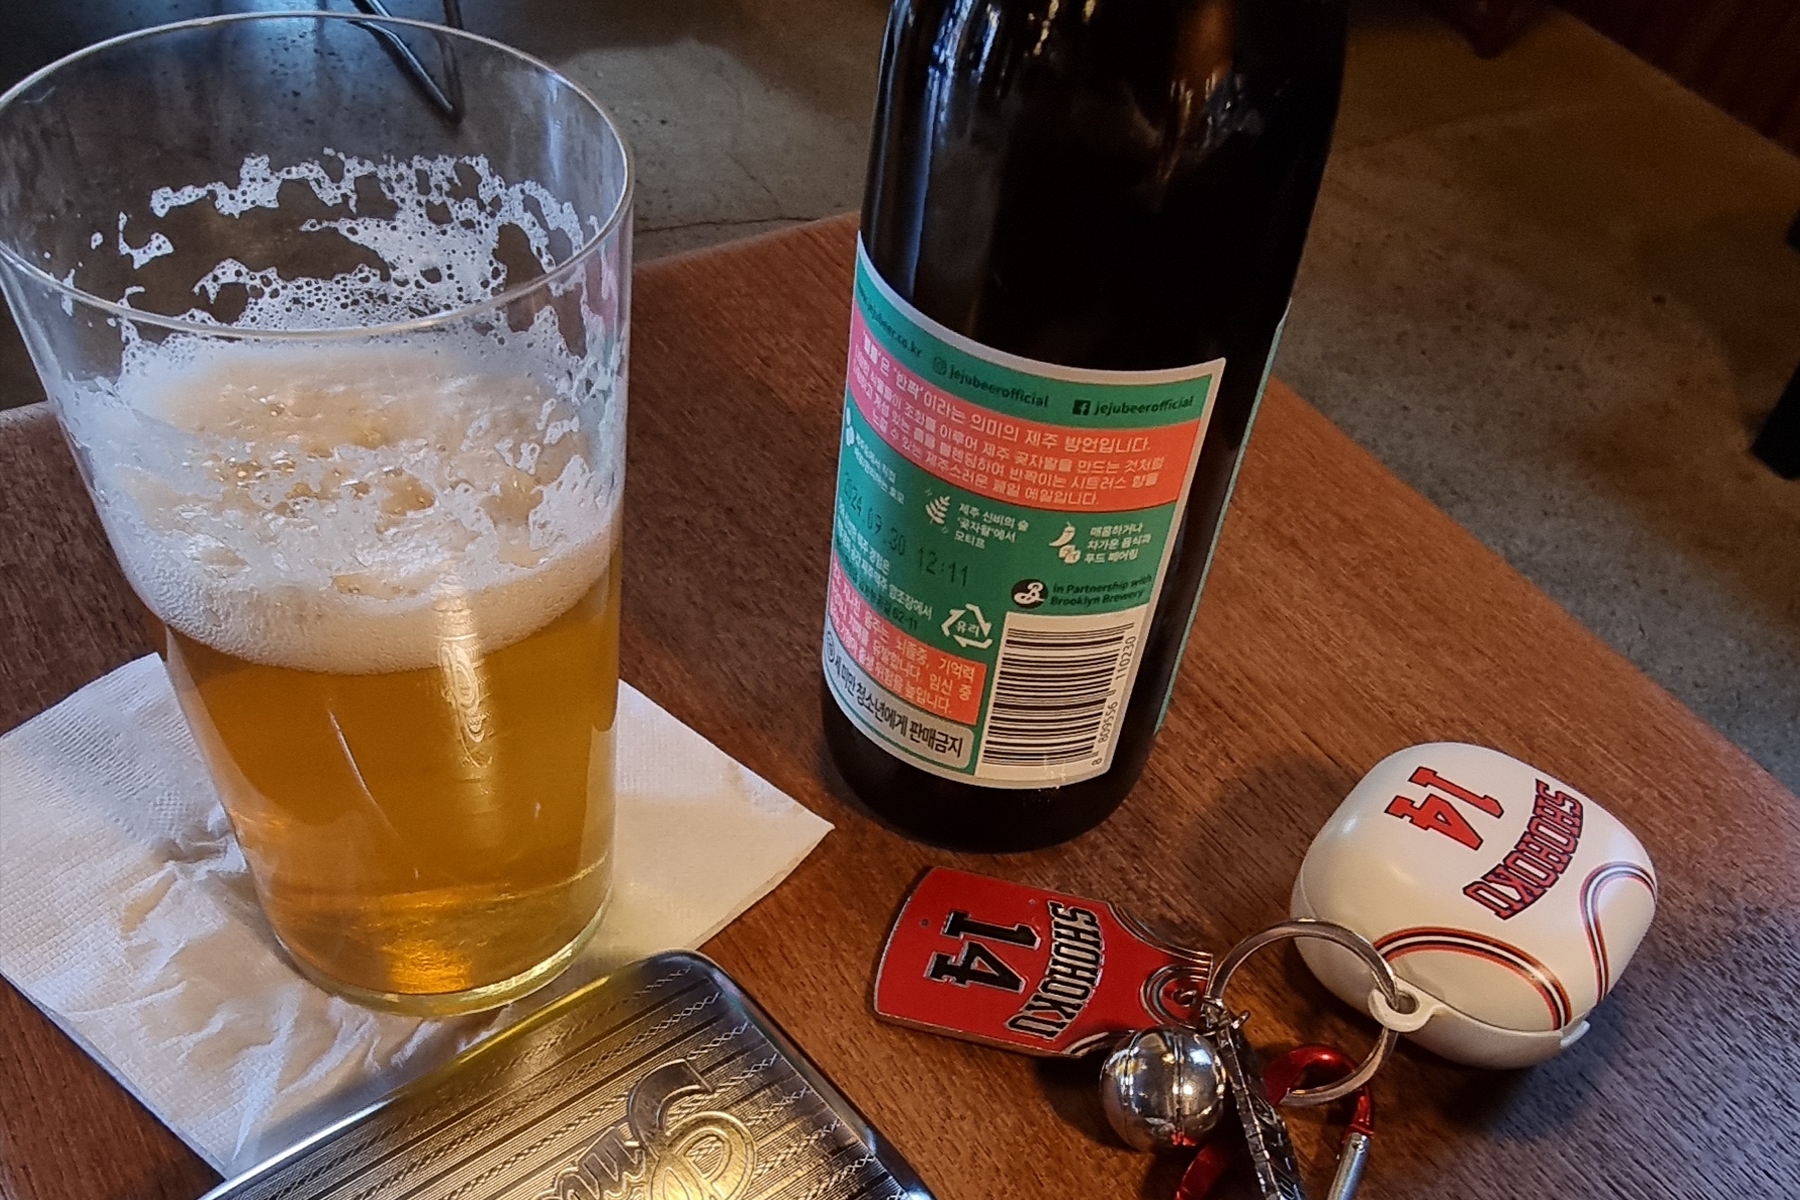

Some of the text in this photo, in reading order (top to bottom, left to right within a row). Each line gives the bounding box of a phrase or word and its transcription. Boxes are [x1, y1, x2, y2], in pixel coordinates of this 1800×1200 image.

[950, 366, 1048, 406] jejubeerofficial
[1095, 396, 1193, 415] jejubeerofficial
[970, 414, 1019, 441] 의미의
[1025, 430, 1058, 448] 제주
[1065, 437, 1149, 453] 방언입니다.
[926, 451, 987, 488] 제주스러운
[982, 441, 1009, 460] 제주
[1077, 460, 1119, 474] 만드는
[1071, 476, 1126, 489] 시트러스
[959, 503, 979, 517] 제주
[983, 511, 1015, 528] 신비의
[1084, 553, 1105, 563] 푸드
[1087, 538, 1119, 550] 차가운
[918, 547, 968, 586] 12:11
[1050, 589, 1144, 607] Brooklyn Brewery
[1066, 581, 1128, 593] Partnership
[864, 611, 889, 643] 음주는
[939, 658, 975, 681] 기억력
[956, 620, 979, 637] 유리
[905, 681, 951, 713] 높입니다.
[929, 673, 953, 696] 임신
[959, 683, 971, 701] 중
[1097, 701, 1119, 743] 809556
[1115, 635, 1137, 681] 110230
[856, 683, 907, 735] 청소년에게
[909, 721, 962, 756] 판매금지
[1384, 765, 1505, 851] 14
[1462, 778, 1584, 921] SHOHOKU
[922, 909, 1042, 995] 14
[1003, 898, 1105, 1042] SHOHOKU
